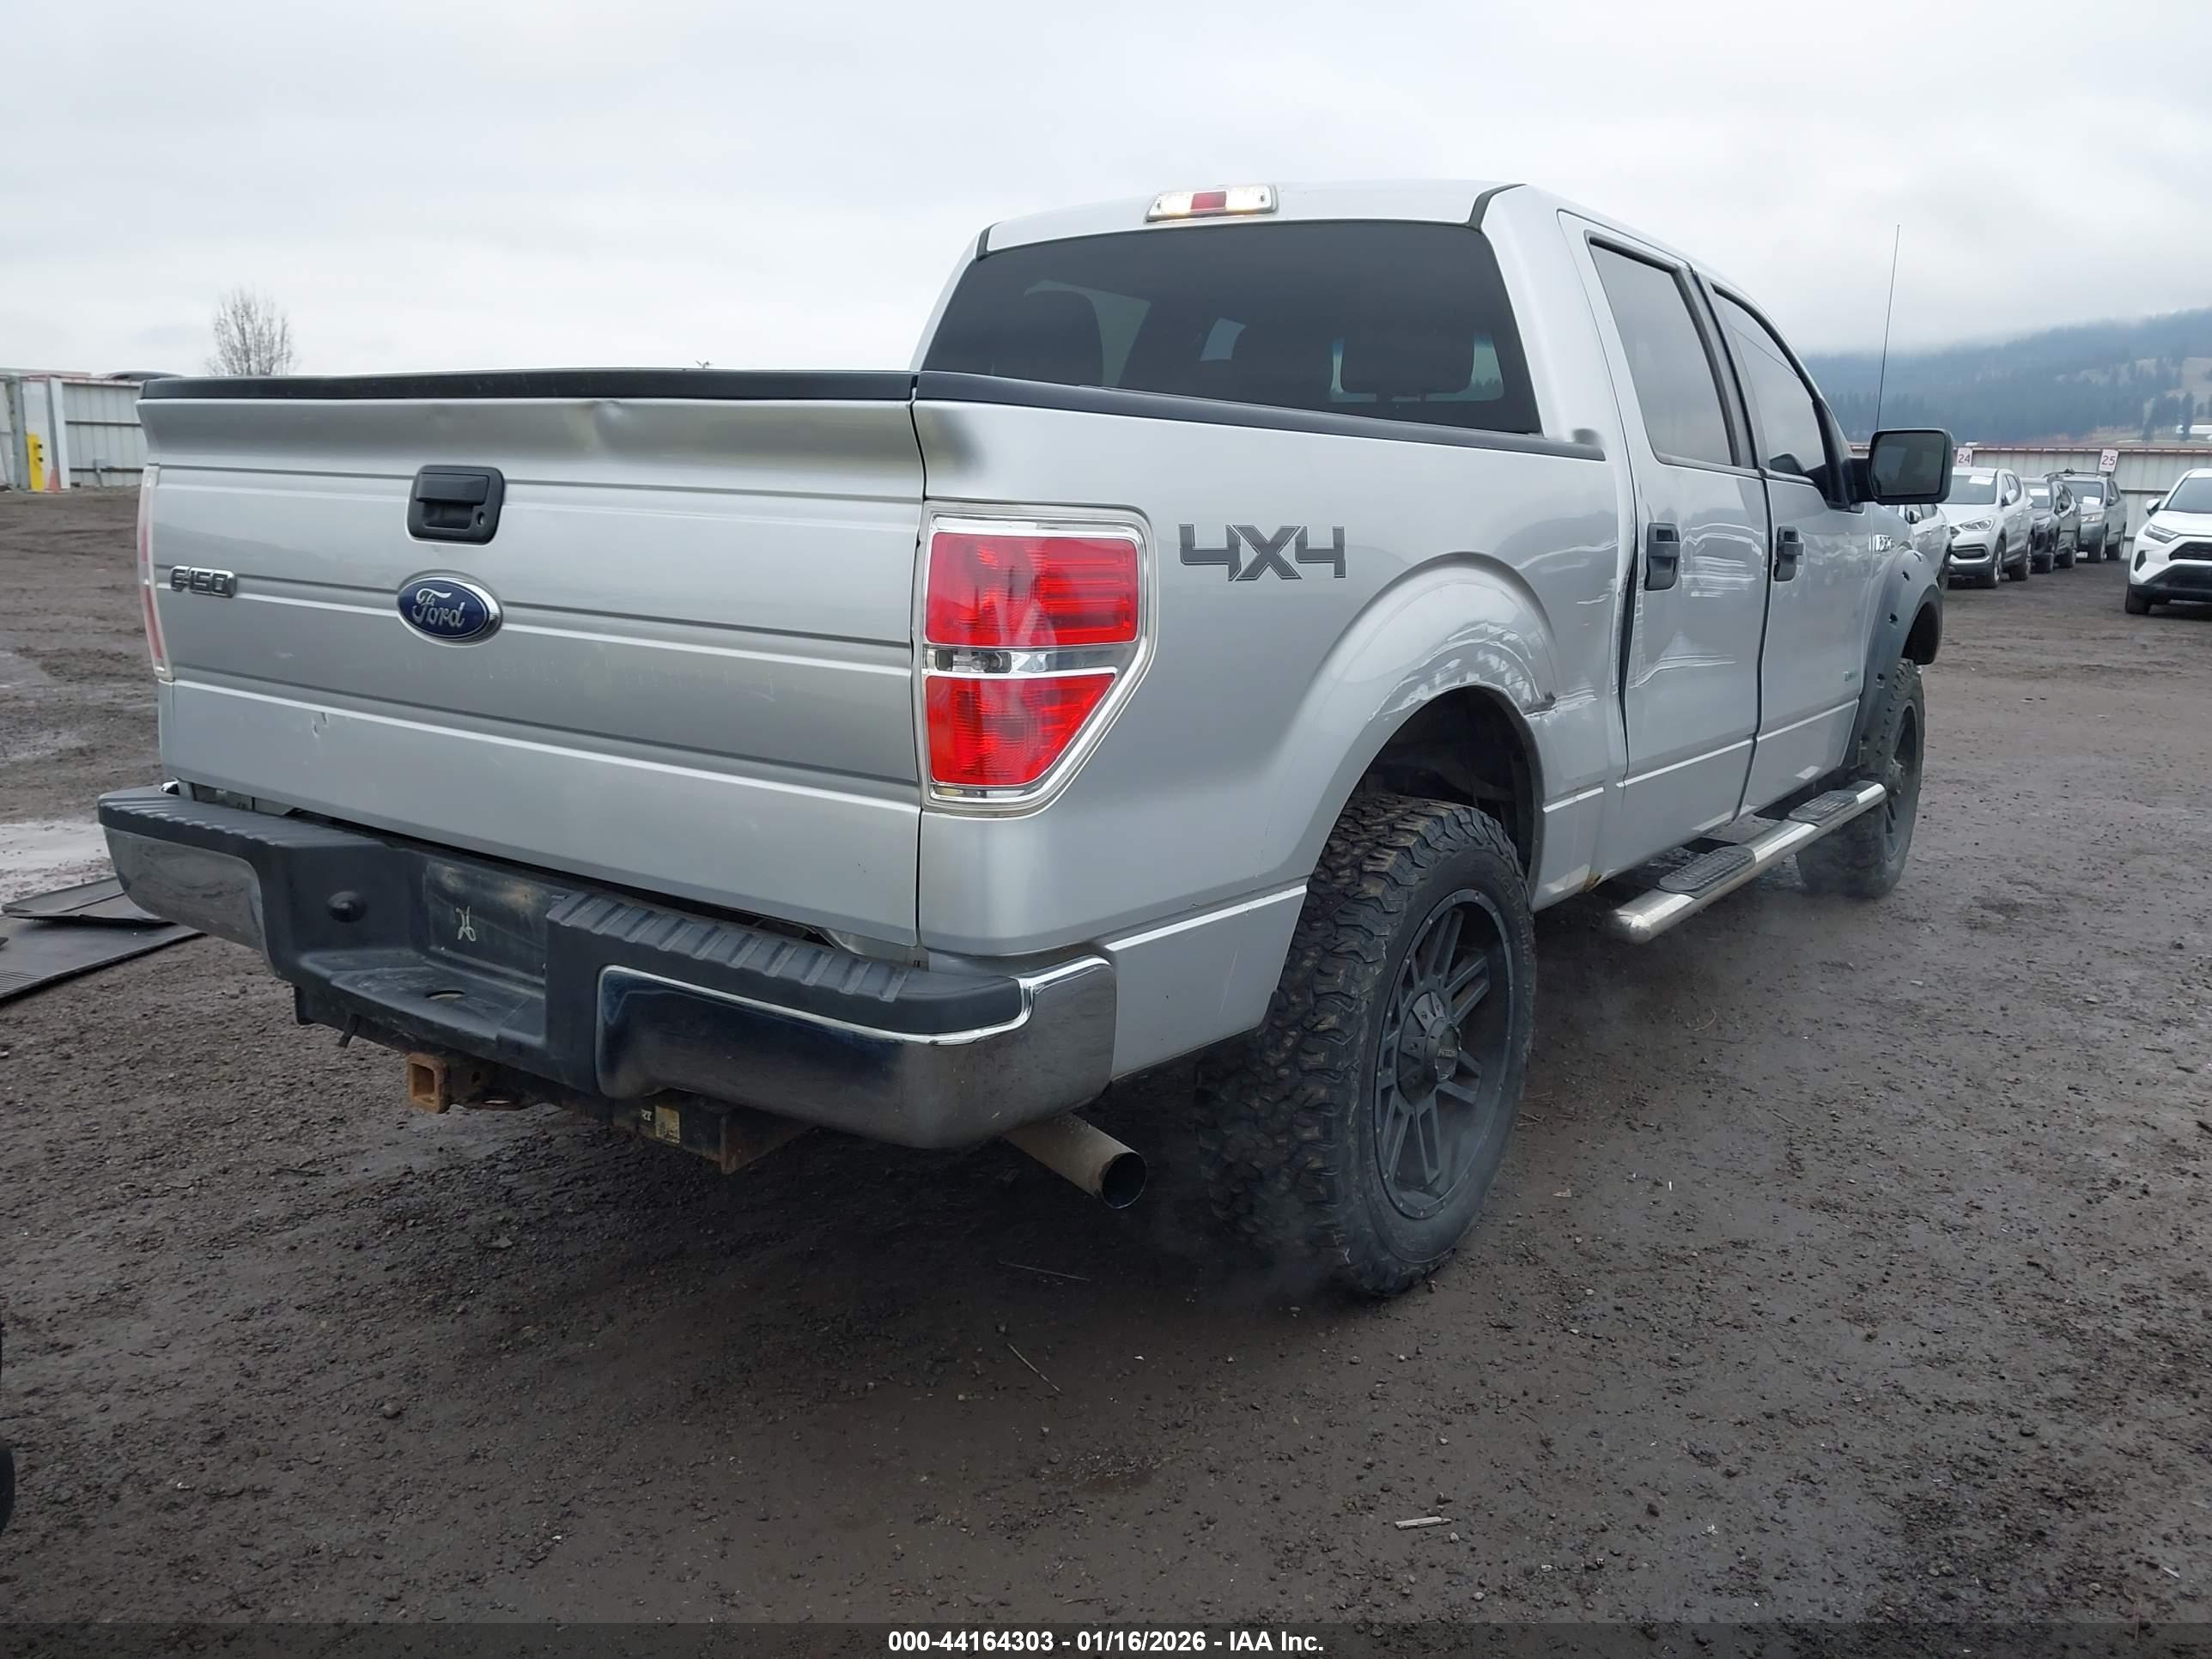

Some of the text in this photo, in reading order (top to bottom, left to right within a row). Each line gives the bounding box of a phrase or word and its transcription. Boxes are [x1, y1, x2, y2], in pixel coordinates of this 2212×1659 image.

[1957, 453, 1971, 464] 24
[2101, 455, 2116, 466] 25
[412, 587, 465, 628] Ford
